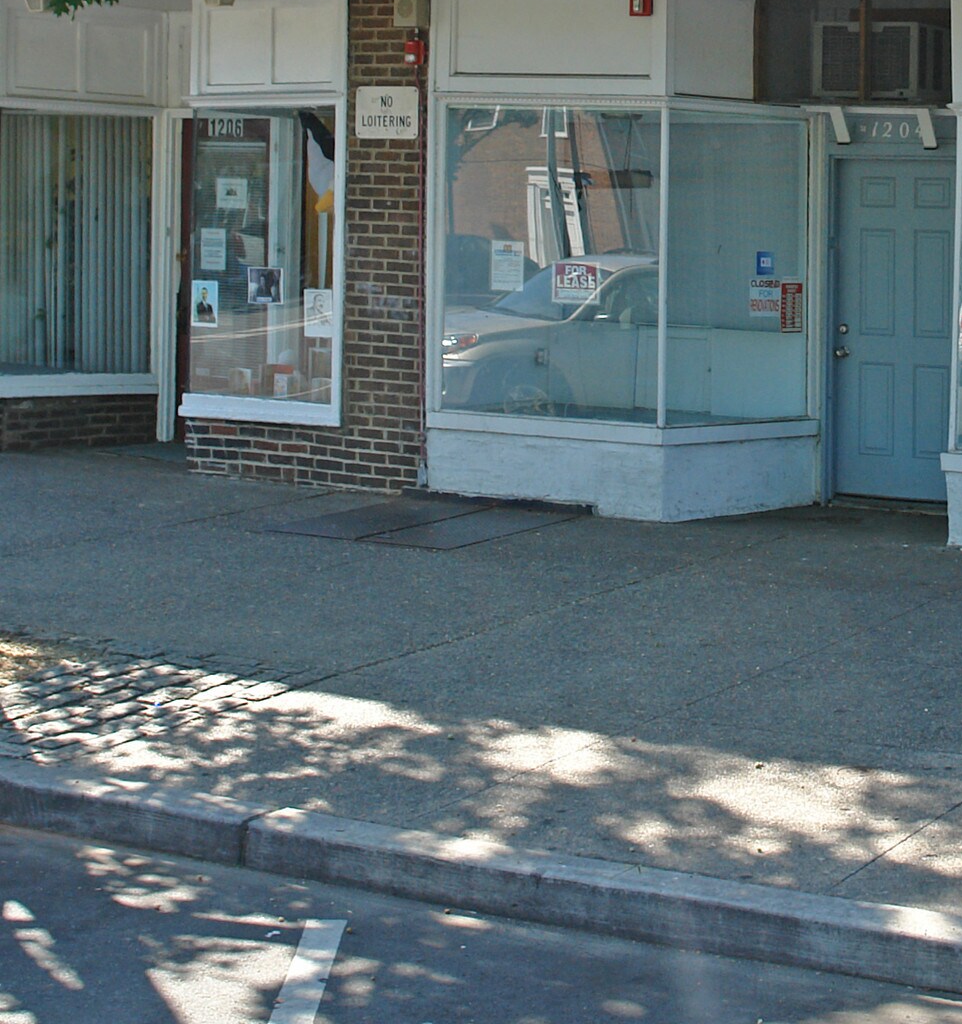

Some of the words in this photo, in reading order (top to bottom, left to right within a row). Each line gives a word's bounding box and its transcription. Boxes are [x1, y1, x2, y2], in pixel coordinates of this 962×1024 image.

[380, 95, 393, 108] NO
[209, 119, 243, 136] 1206
[361, 114, 412, 128] LOITERING
[565, 265, 587, 275] FOR
[556, 275, 596, 289] LEASE
[751, 279, 780, 288] CLOSED
[758, 289, 773, 297] FOR
